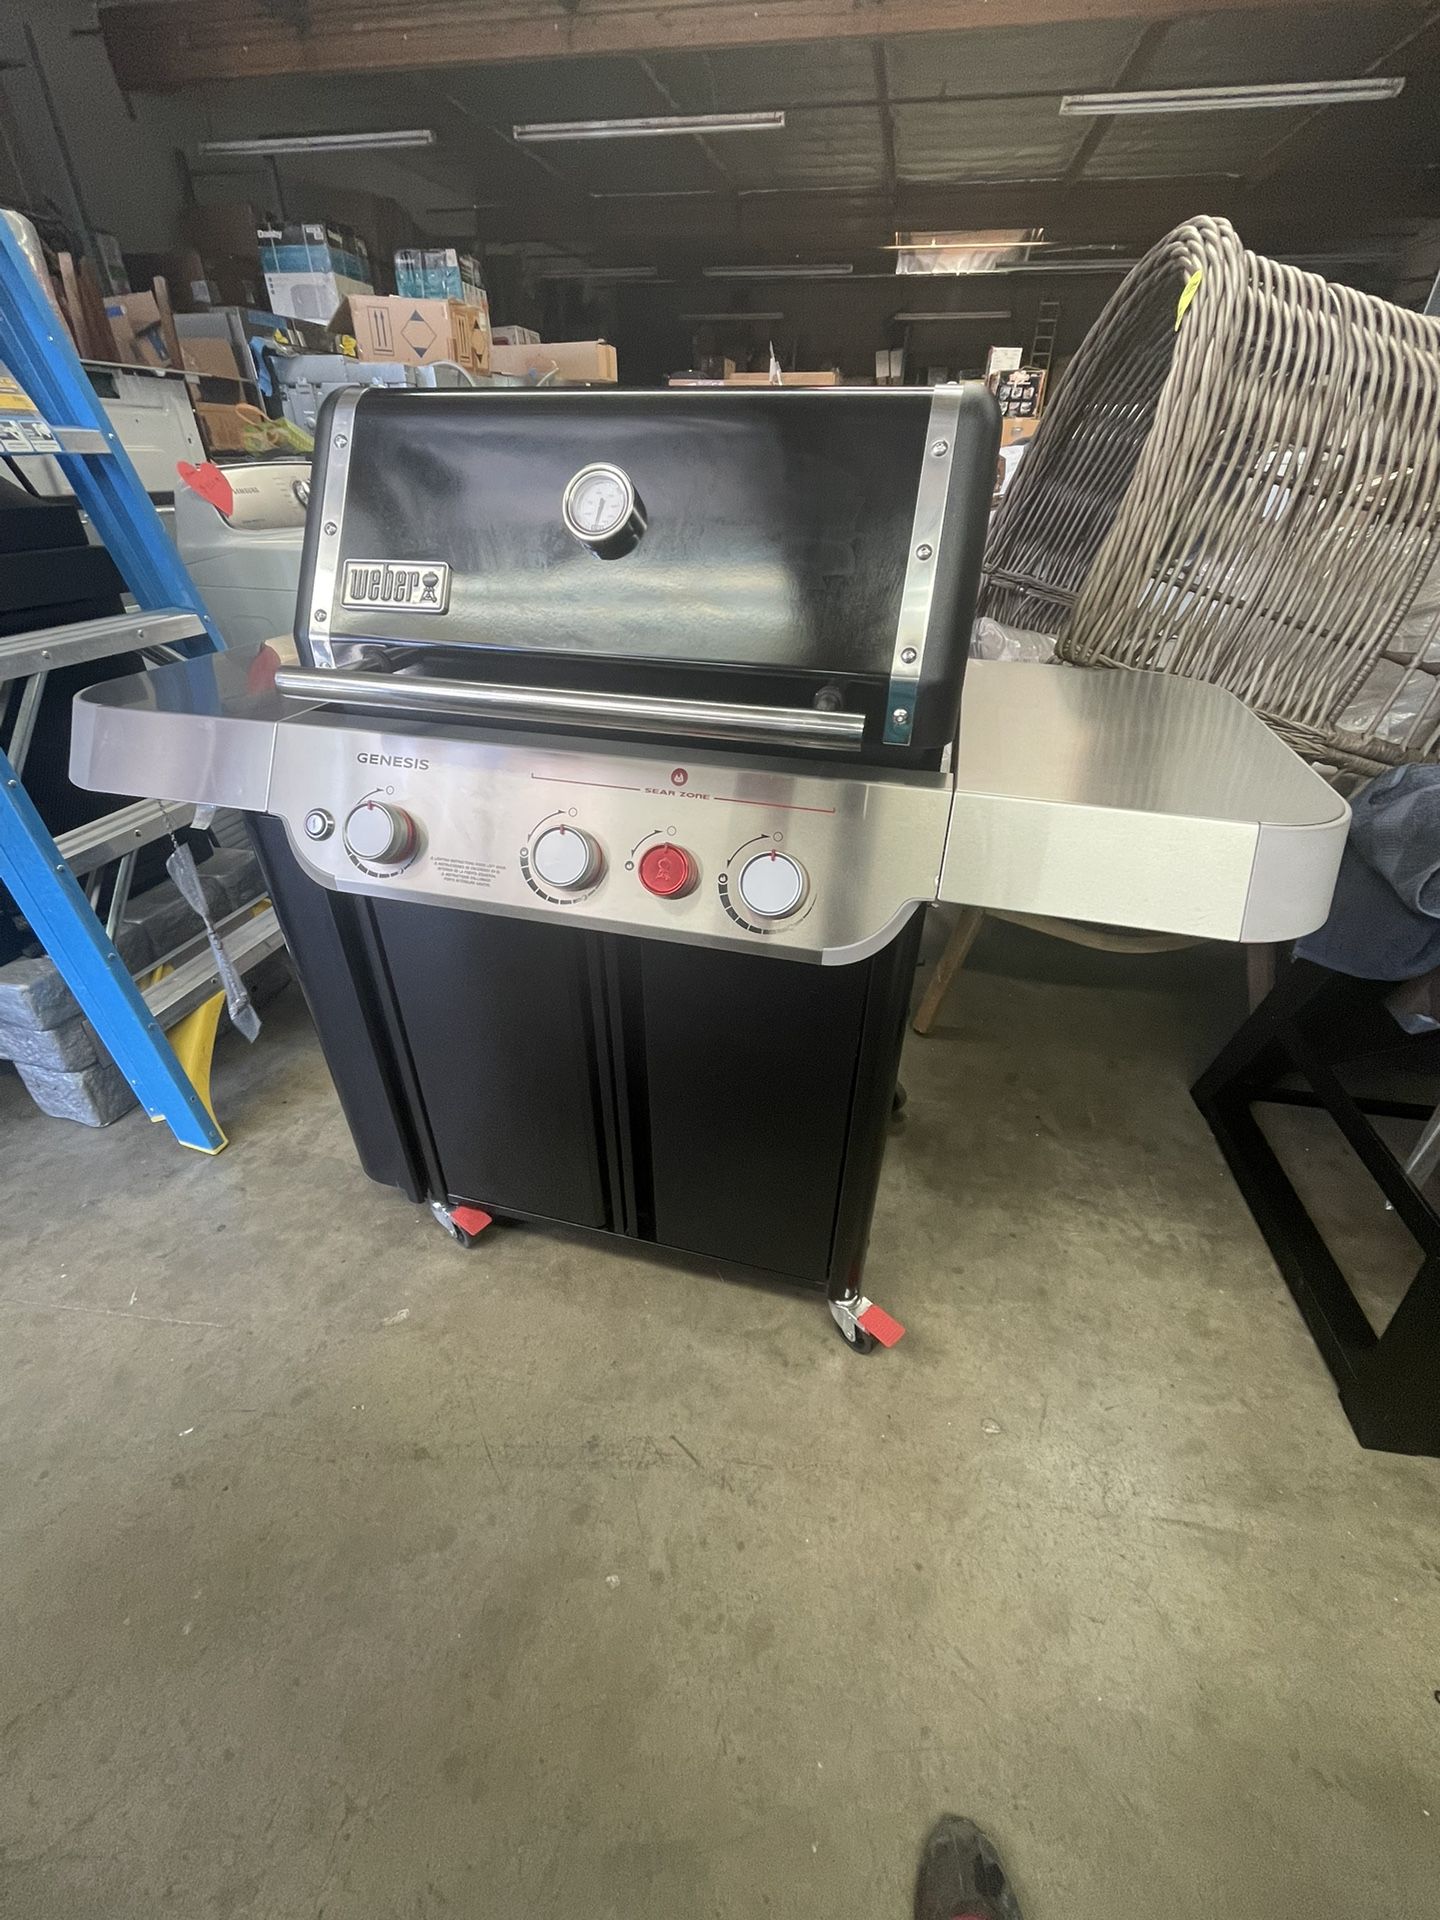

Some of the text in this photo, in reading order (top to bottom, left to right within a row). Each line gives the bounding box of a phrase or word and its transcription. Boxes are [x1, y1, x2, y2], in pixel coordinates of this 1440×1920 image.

[350, 563, 420, 602] weber
[357, 752, 430, 771] GENESIS
[644, 787, 711, 800] SEAR ZONE
